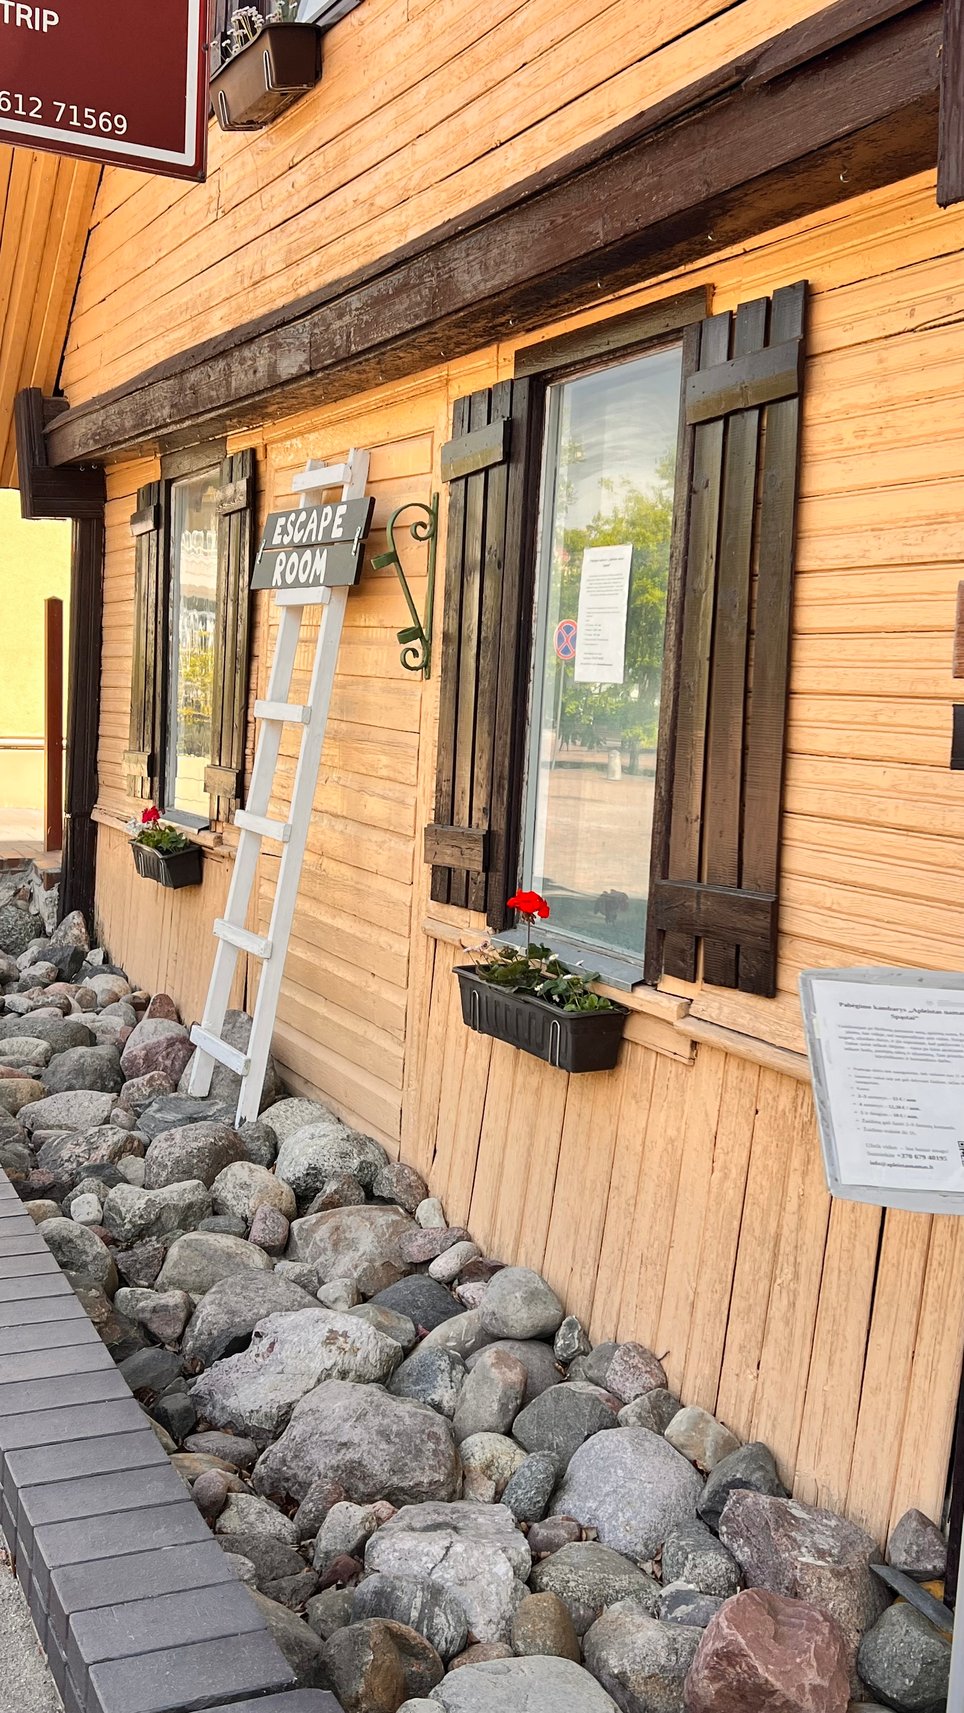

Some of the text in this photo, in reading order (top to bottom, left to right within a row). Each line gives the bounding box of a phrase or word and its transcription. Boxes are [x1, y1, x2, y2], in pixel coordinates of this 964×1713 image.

[0, 0, 59, 32] TRIP
[0, 90, 128, 135] 612 71569
[272, 504, 347, 545] ESCAPE
[272, 548, 328, 587] ROOM
